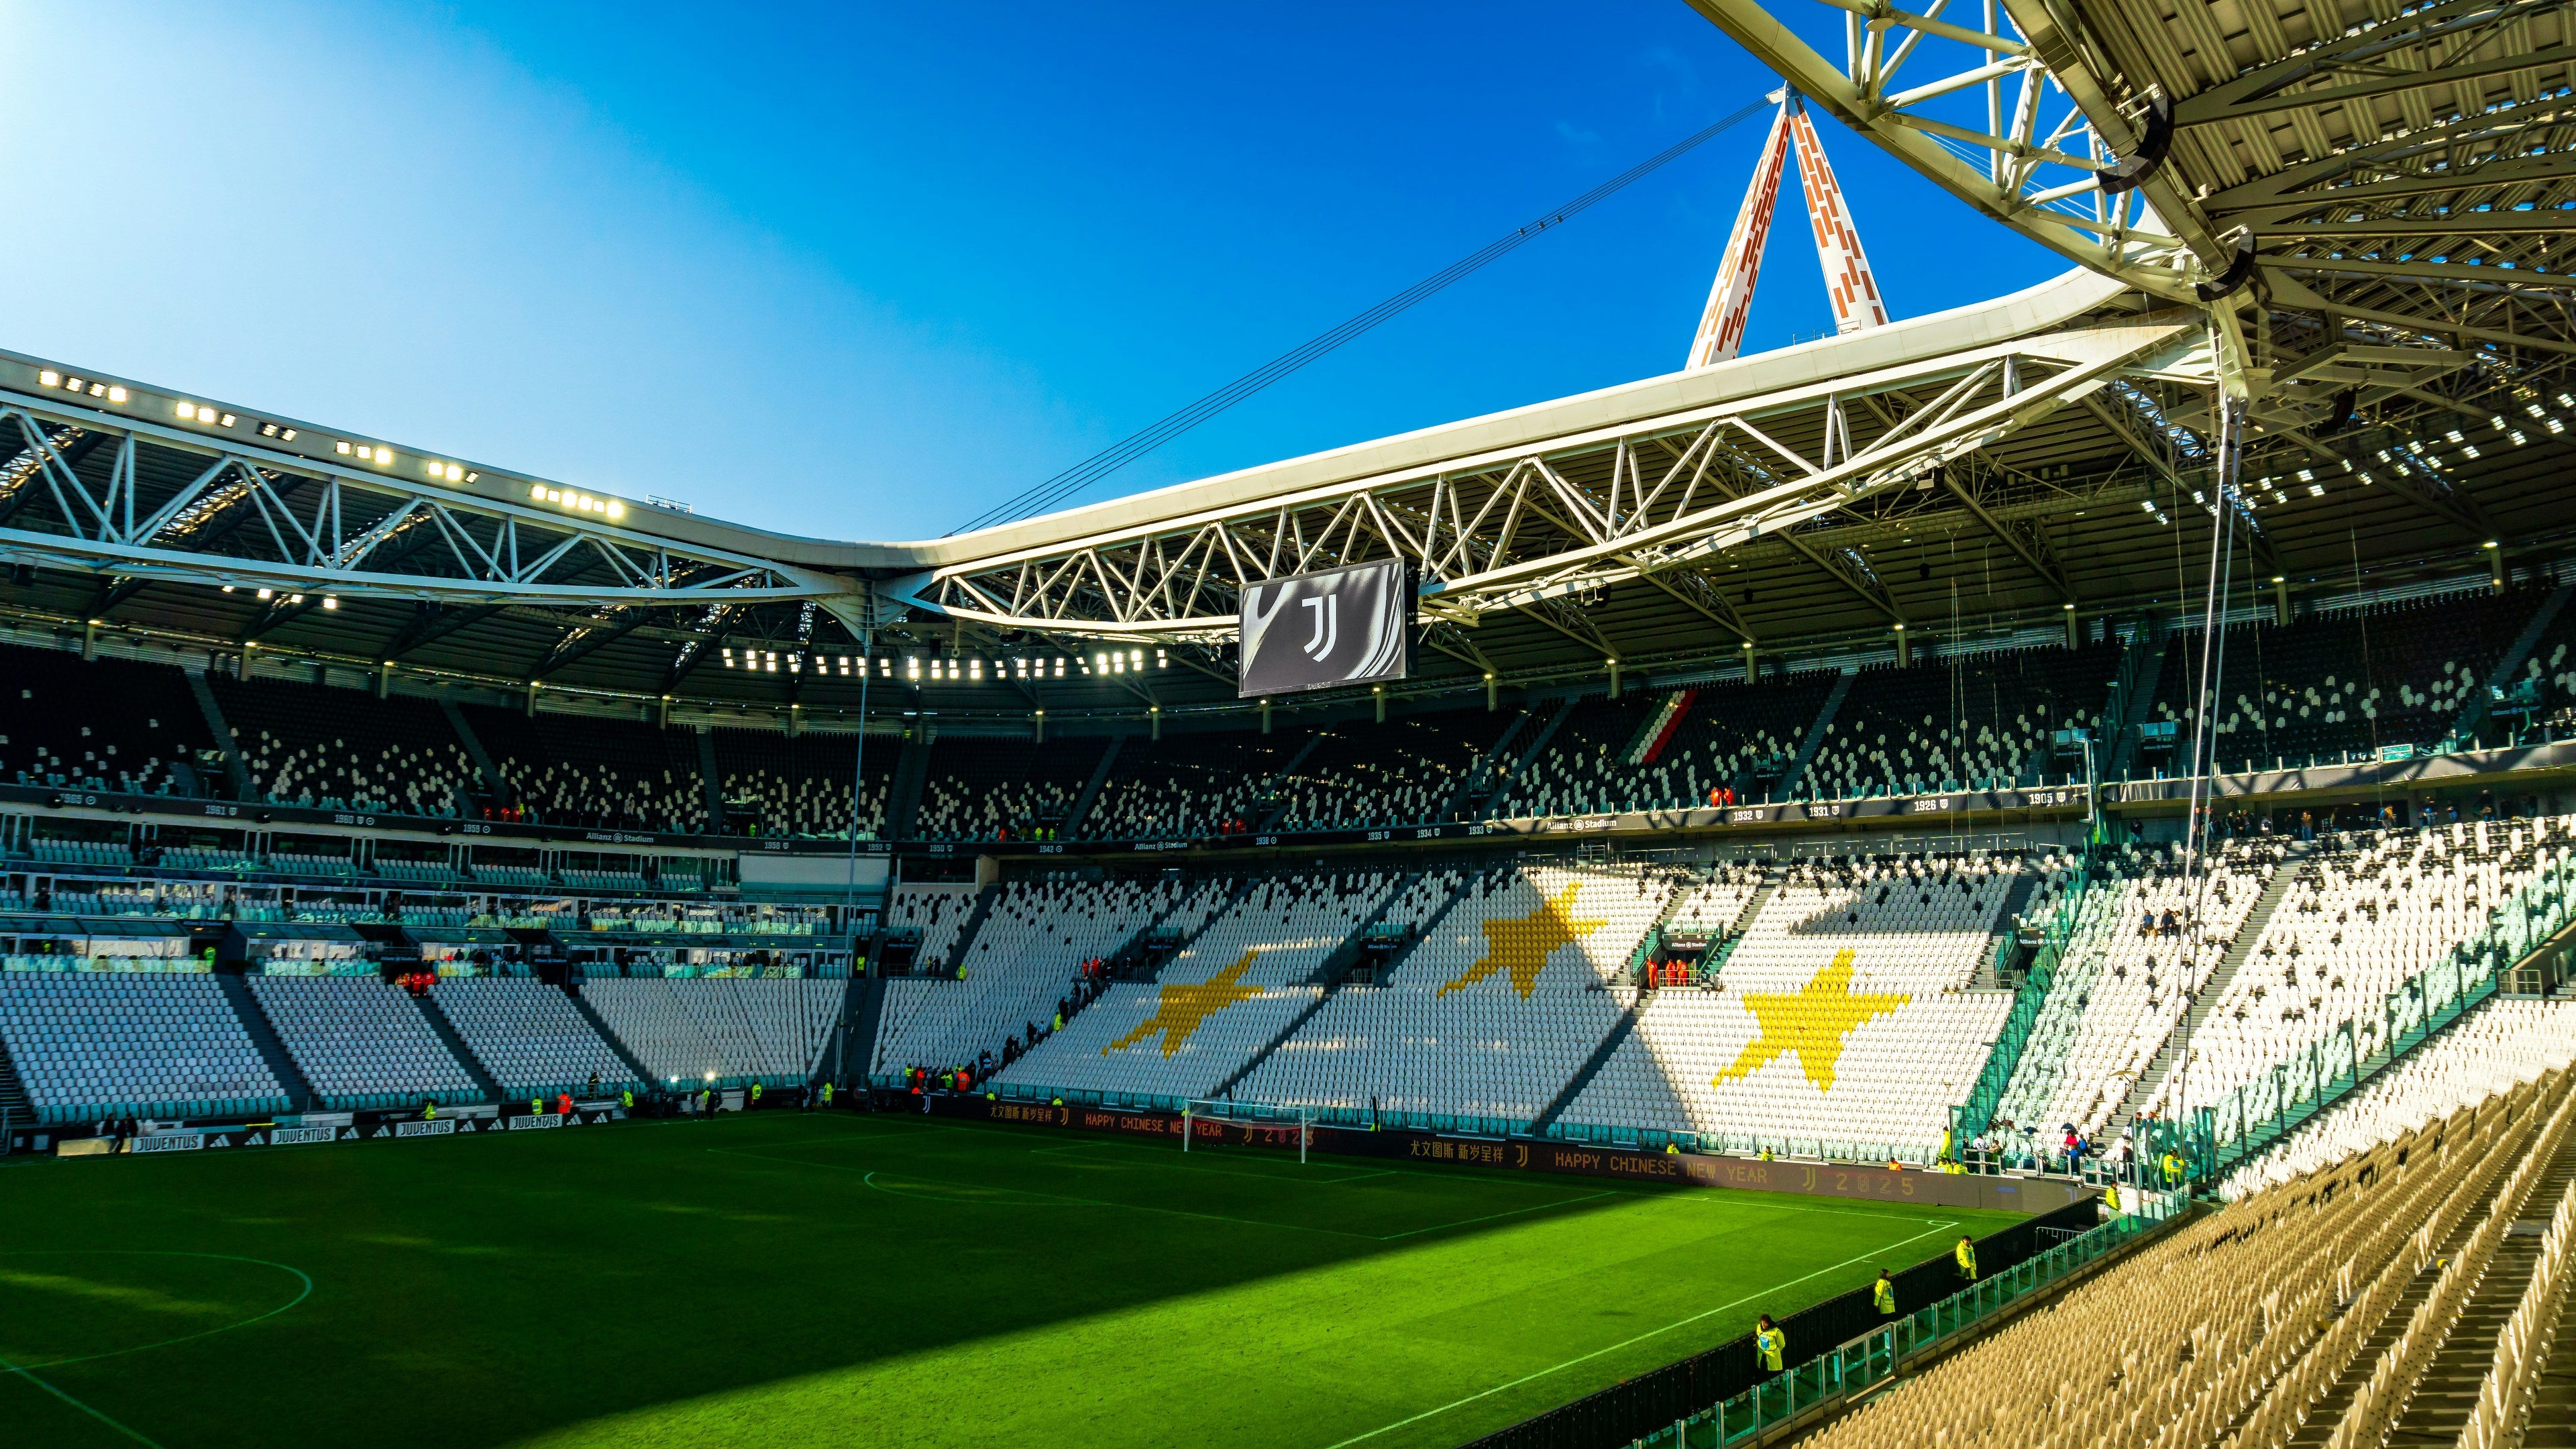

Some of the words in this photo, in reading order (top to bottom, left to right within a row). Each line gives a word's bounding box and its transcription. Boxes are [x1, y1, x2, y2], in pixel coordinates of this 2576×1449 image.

[2029, 793, 2053, 804] 1905
[1809, 806, 1829, 817] 1931
[1914, 800, 1937, 812] 1926
[1733, 810, 1753, 821] 1932
[1546, 821, 1573, 830] Allianz
[1585, 818, 1617, 828] Stadium
[1368, 831, 1382, 841] 1935
[1417, 829, 1432, 839] 1934
[1468, 826, 1484, 835] 1933
[586, 833, 612, 841] Allianz
[624, 835, 654, 843] Stadium
[1256, 837, 1269, 845] 1938
[765, 841, 781, 850] 1958
[867, 843, 883, 851] 1952
[1039, 845, 1054, 853] 1942
[400, 1121, 450, 1136] JUVENTUS
[1085, 1113, 1115, 1127] HAPPY
[1120, 1116, 1164, 1132] CHINESE
[1169, 1121, 1186, 1134] NE
[1195, 1123, 1222, 1137] YEAR
[276, 1128, 331, 1143] JUVENTUS
[138, 1136, 198, 1151] JUVENTUS
[1411, 1140, 1454, 1159] 尤文图斯
[1458, 1144, 1503, 1163] 新岁呈祥
[1555, 1152, 1601, 1169] HAPPY
[1610, 1156, 1676, 1176] CHINESE
[1686, 1162, 1716, 1179] NEW
[1727, 1165, 1767, 1183] YEAR
